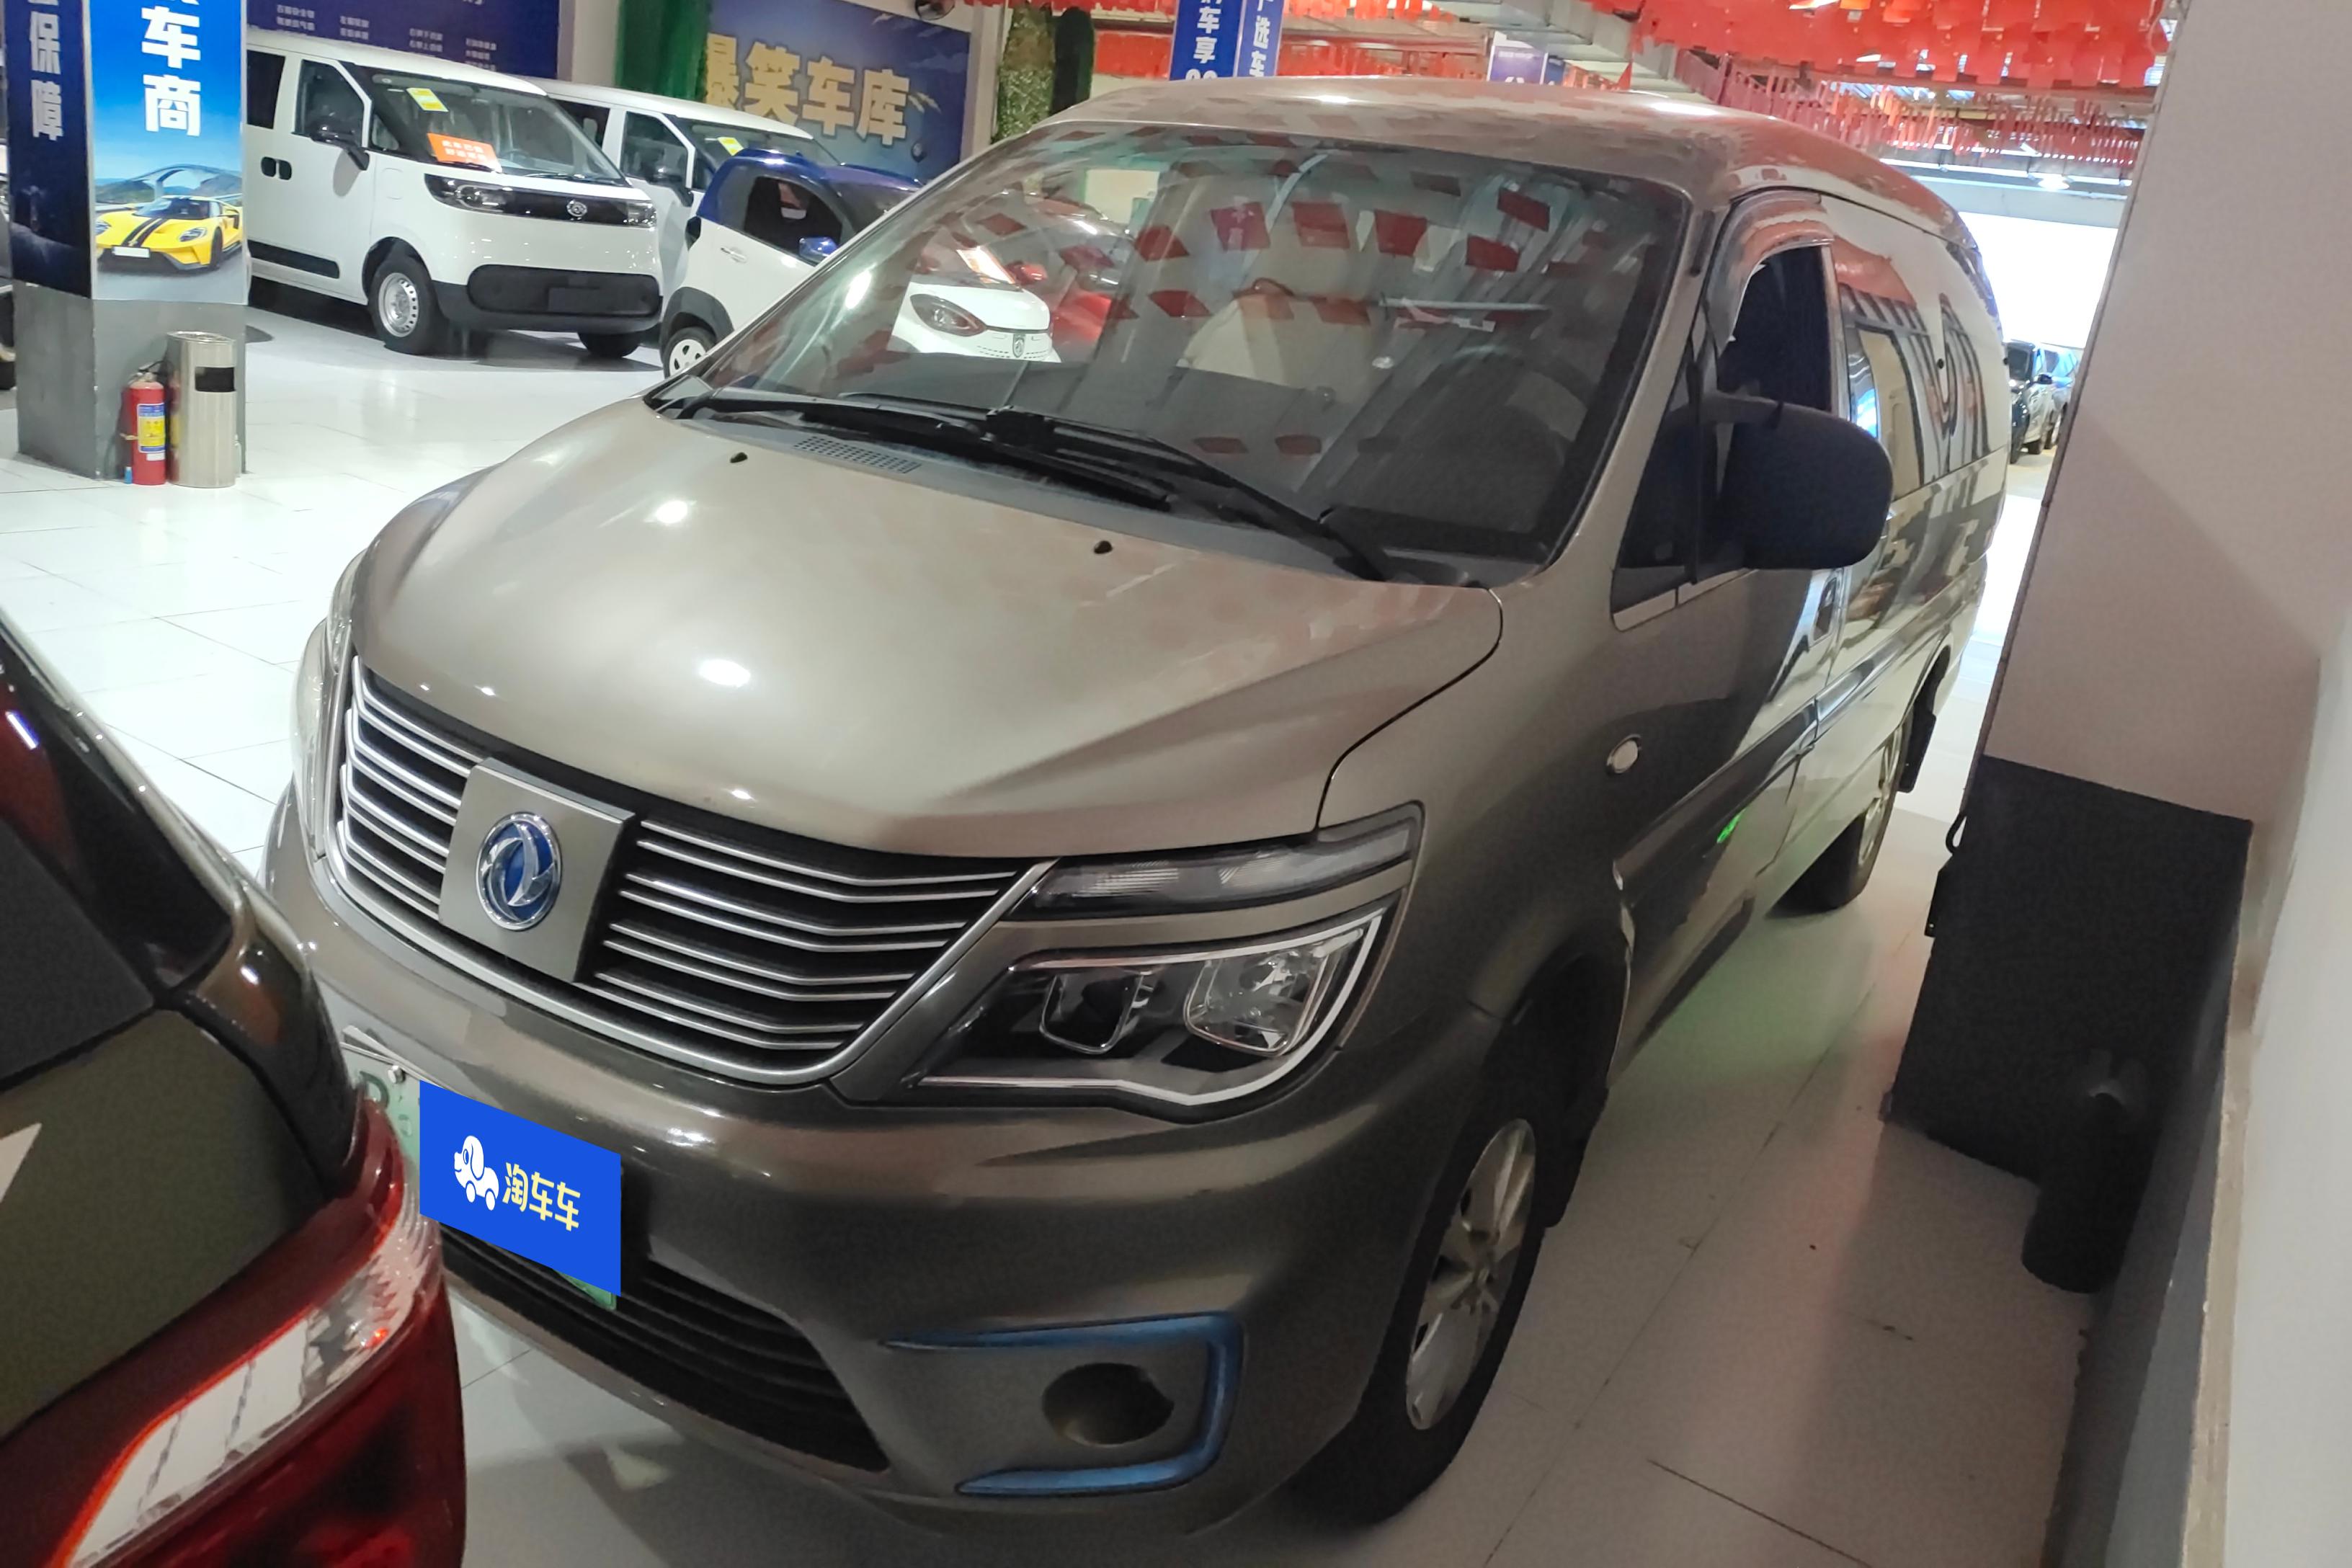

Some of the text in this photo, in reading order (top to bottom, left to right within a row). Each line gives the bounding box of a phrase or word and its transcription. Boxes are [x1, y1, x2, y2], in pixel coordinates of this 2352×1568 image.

[29, 0, 63, 141] 保障
[141, 0, 201, 136] 车商
[1193, 0, 1223, 63] 车享
